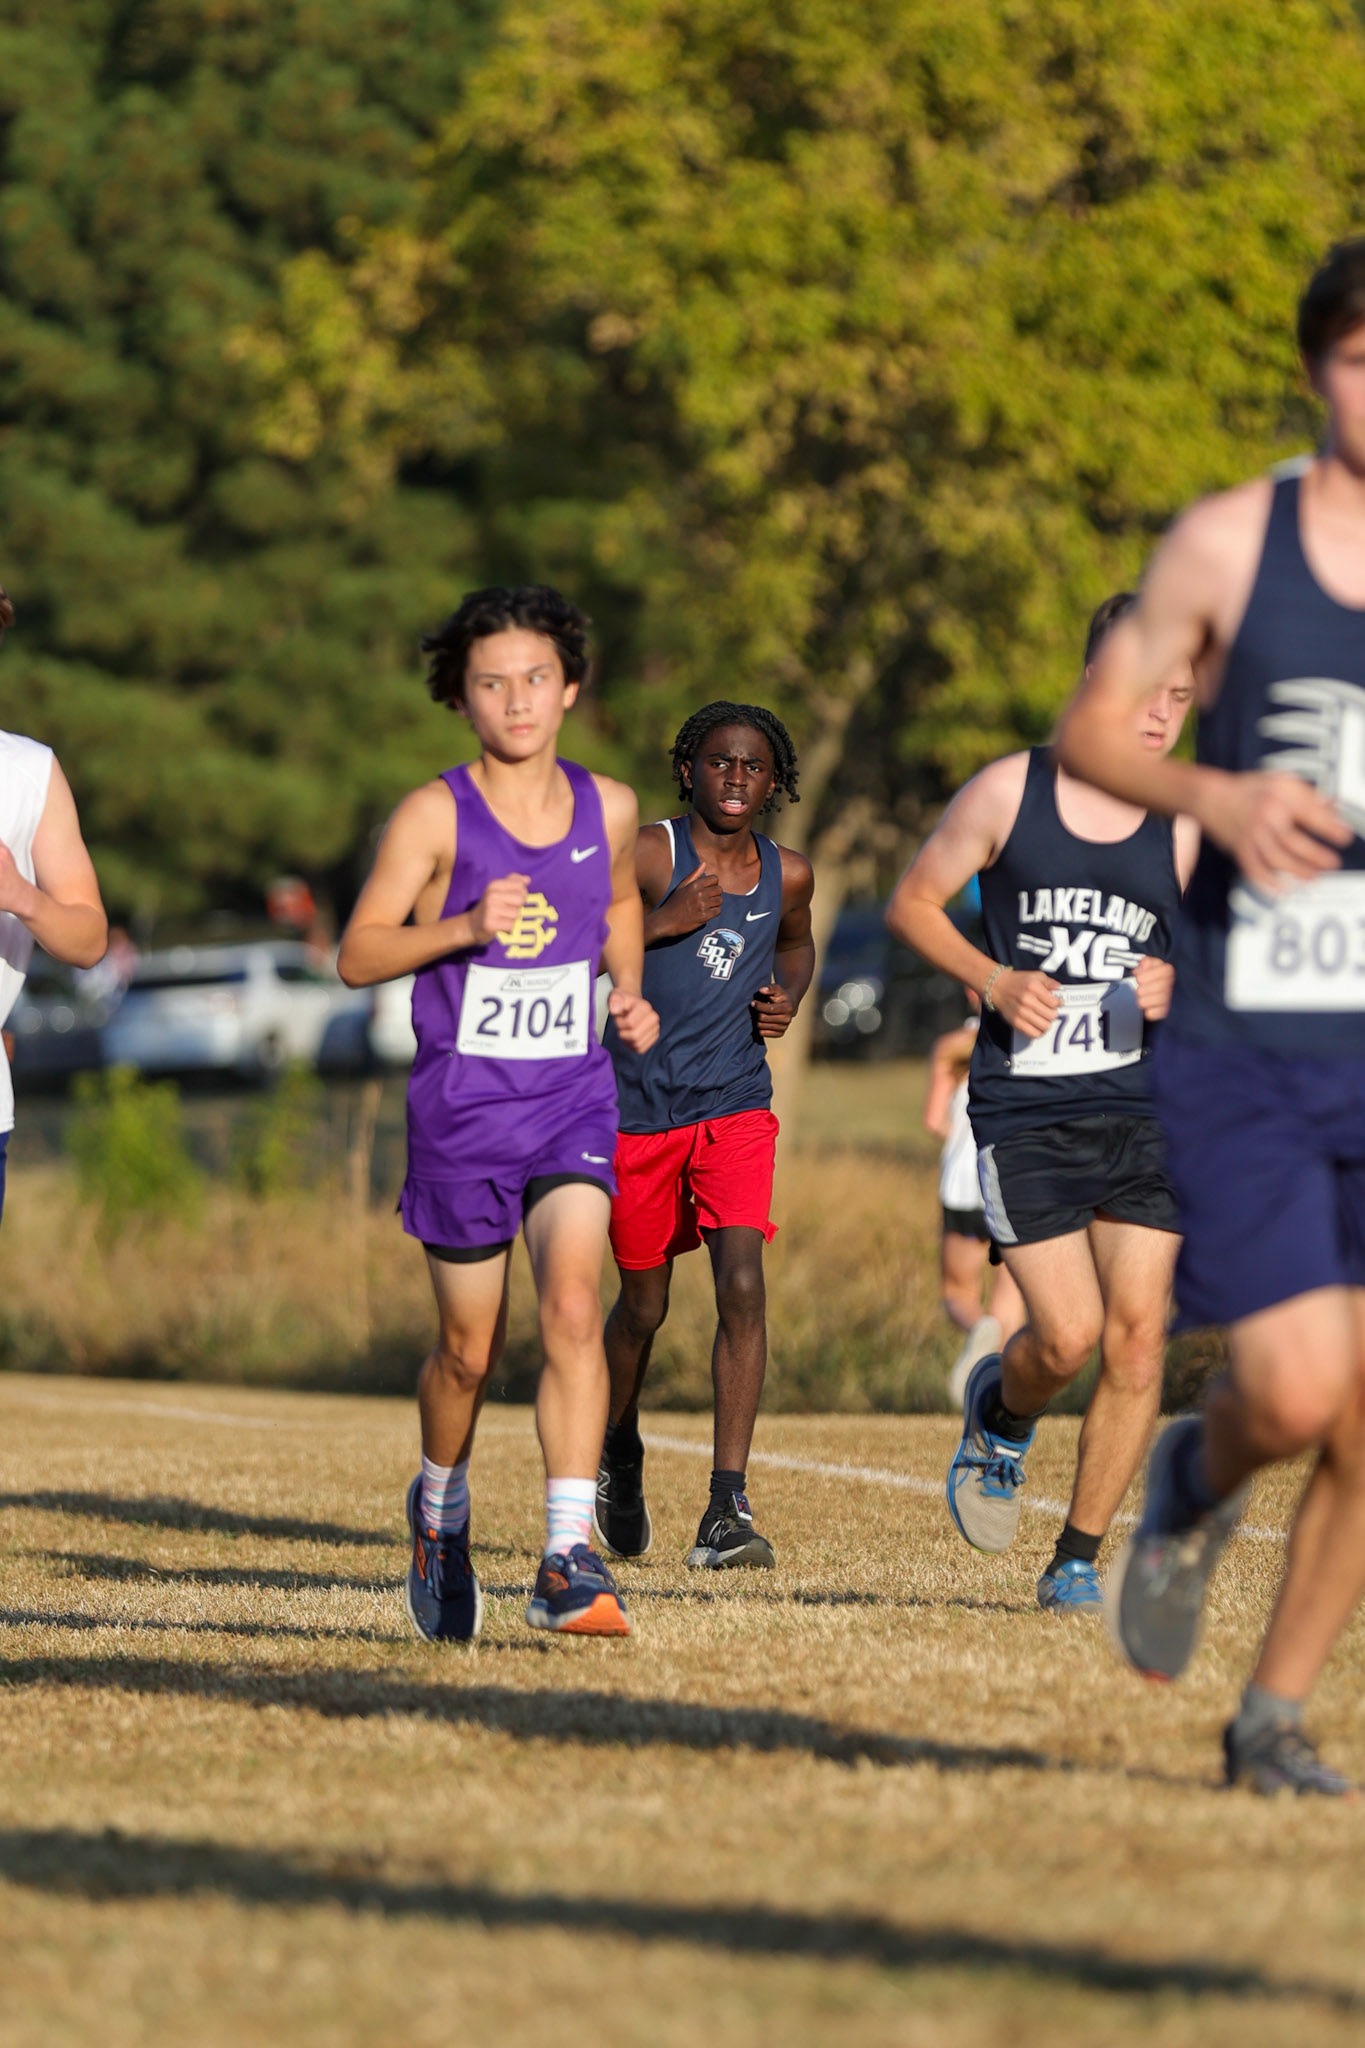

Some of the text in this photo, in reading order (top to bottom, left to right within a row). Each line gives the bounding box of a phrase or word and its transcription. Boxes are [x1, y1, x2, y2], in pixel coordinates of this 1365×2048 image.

[1018, 887, 1157, 943] LAKELAND
[700, 936, 733, 978] SBA
[1039, 925, 1131, 981] XC
[476, 993, 575, 1038] 2104
